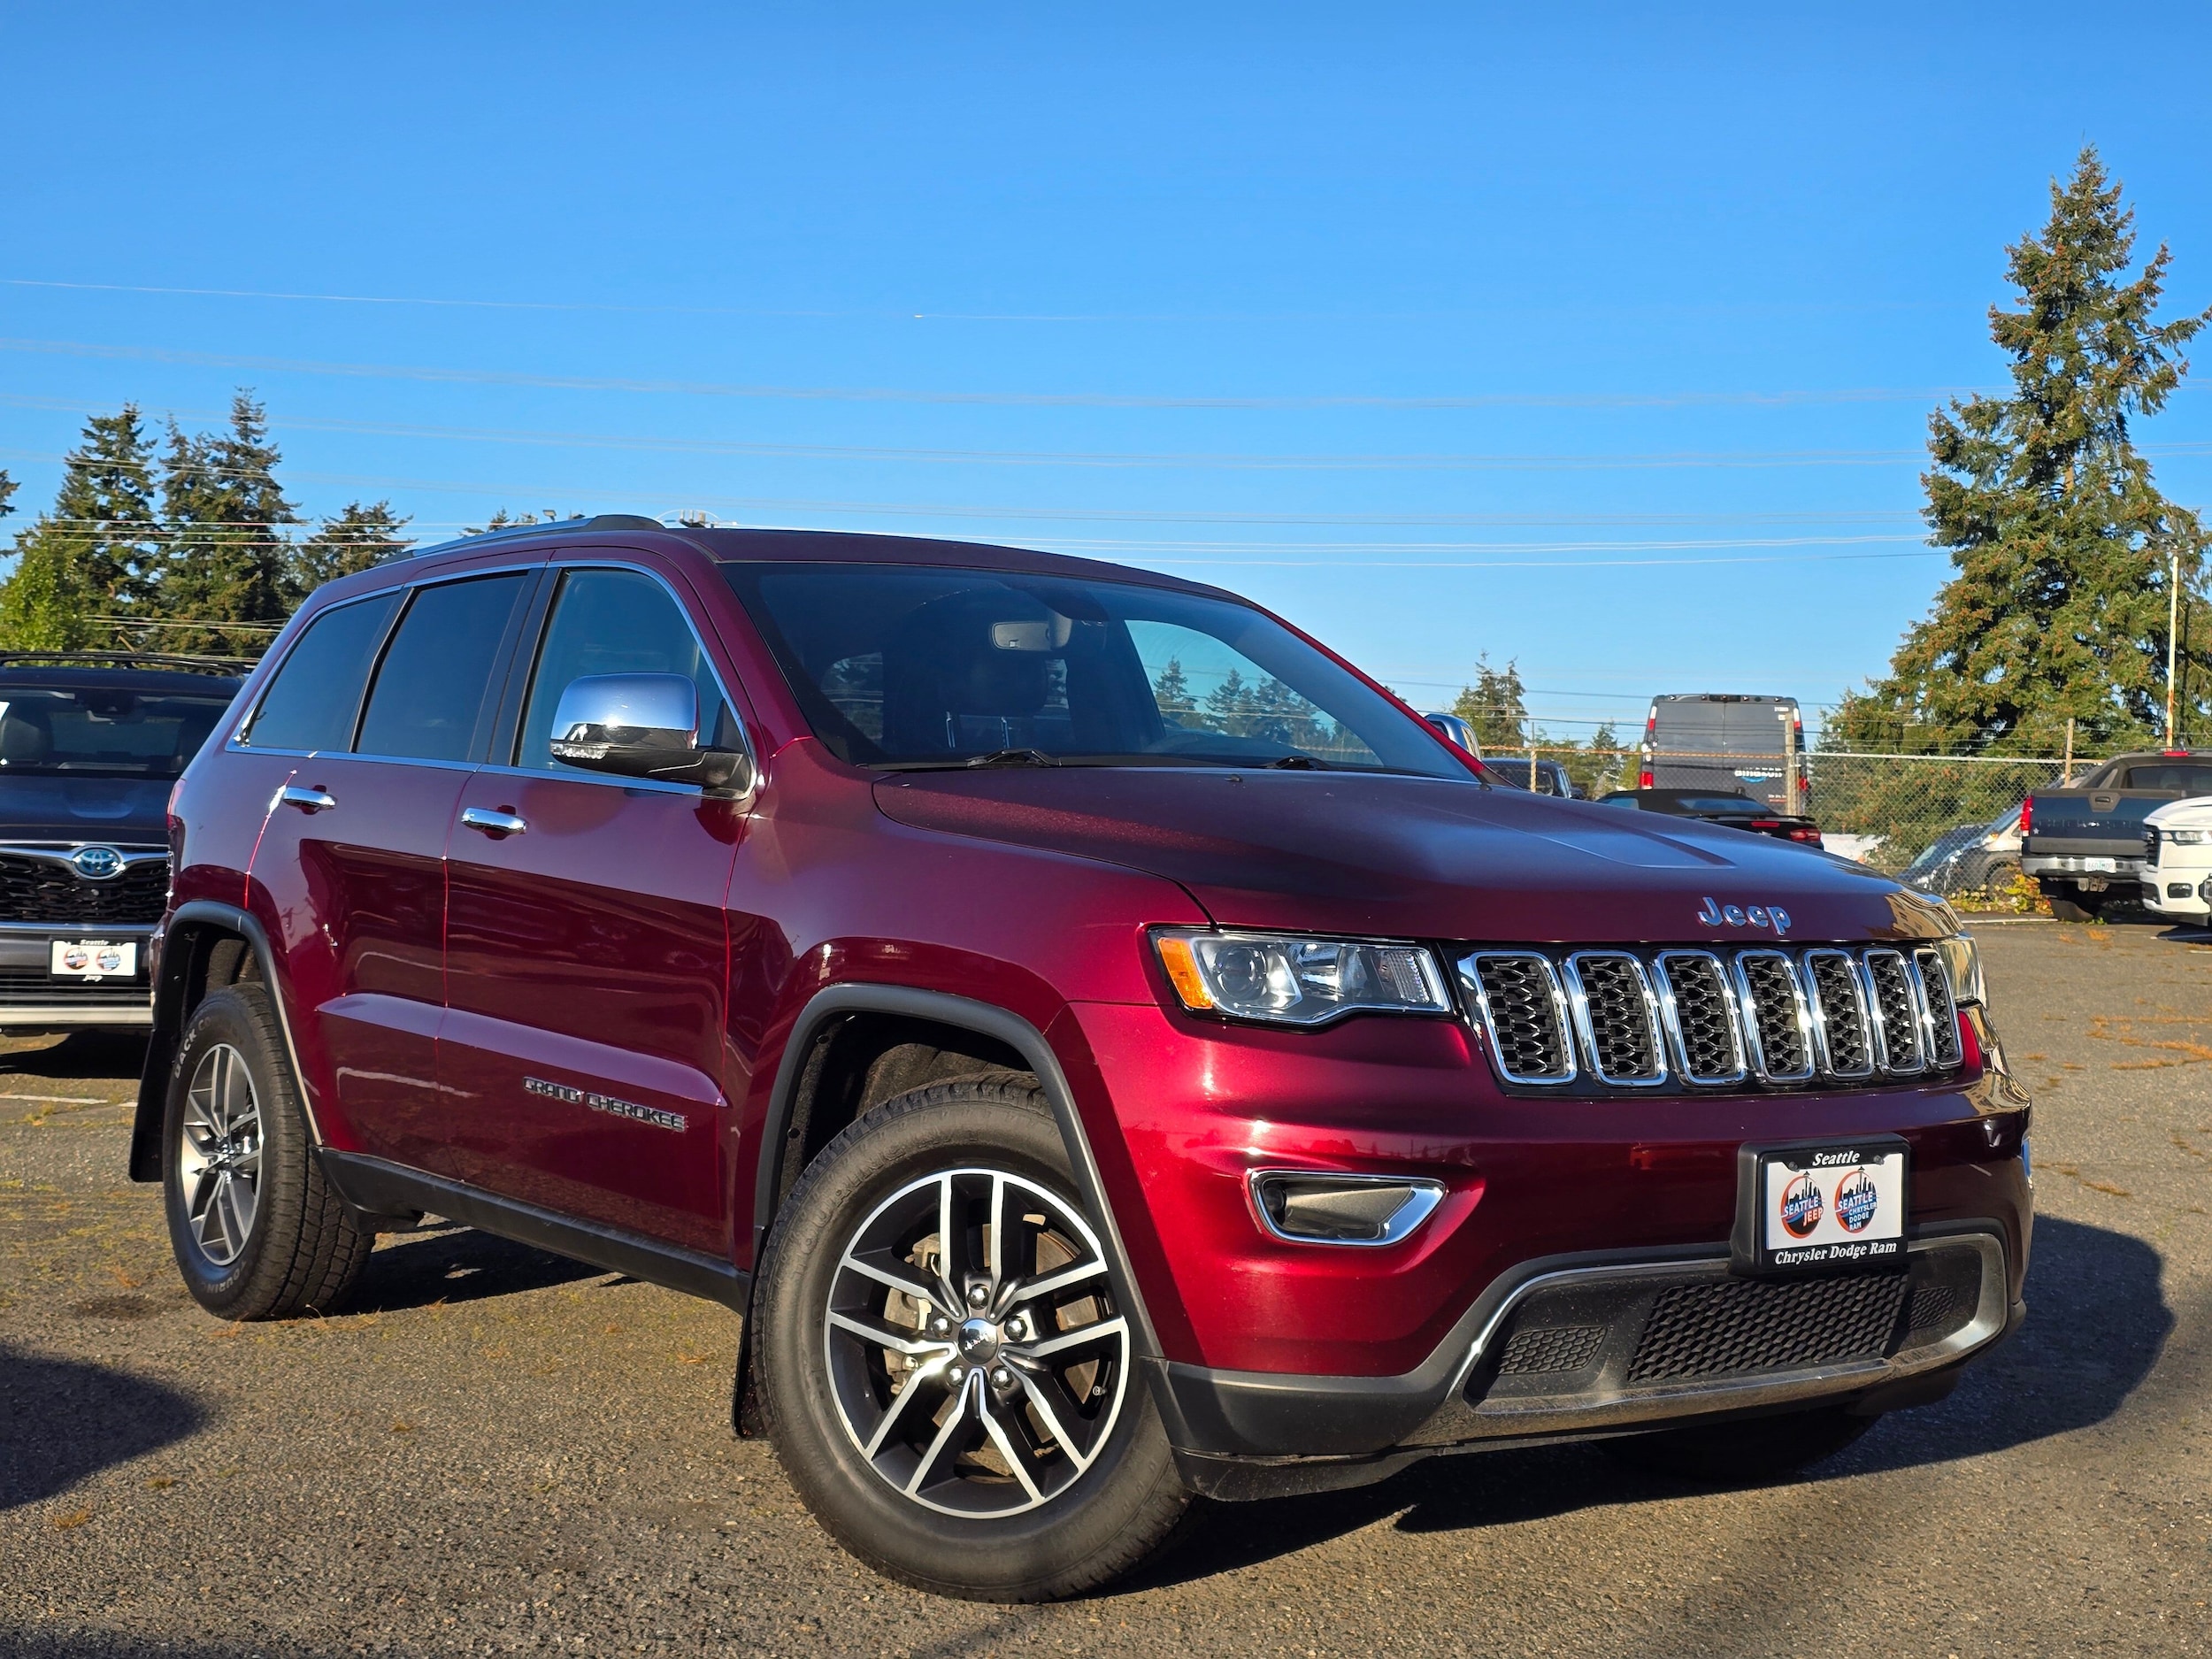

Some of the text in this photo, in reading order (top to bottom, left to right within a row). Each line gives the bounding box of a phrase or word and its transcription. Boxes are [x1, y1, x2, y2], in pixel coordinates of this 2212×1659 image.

[1697, 896, 1791, 935] Jeep
[523, 1076, 687, 1133] GRAND CHEROKEE
[1812, 1150, 1860, 1166] Seattle
[1784, 1195, 1819, 1215] SEATTLE
[1838, 1191, 1873, 1210] SEATTLE
[1848, 1202, 1878, 1216] CHRYSLER
[1803, 1207, 1824, 1226] JEEP
[1848, 1211, 1870, 1223] DODGE
[1848, 1222, 1862, 1231] RAM
[1775, 1241, 1897, 1265] Chrysler Dodge Ram
